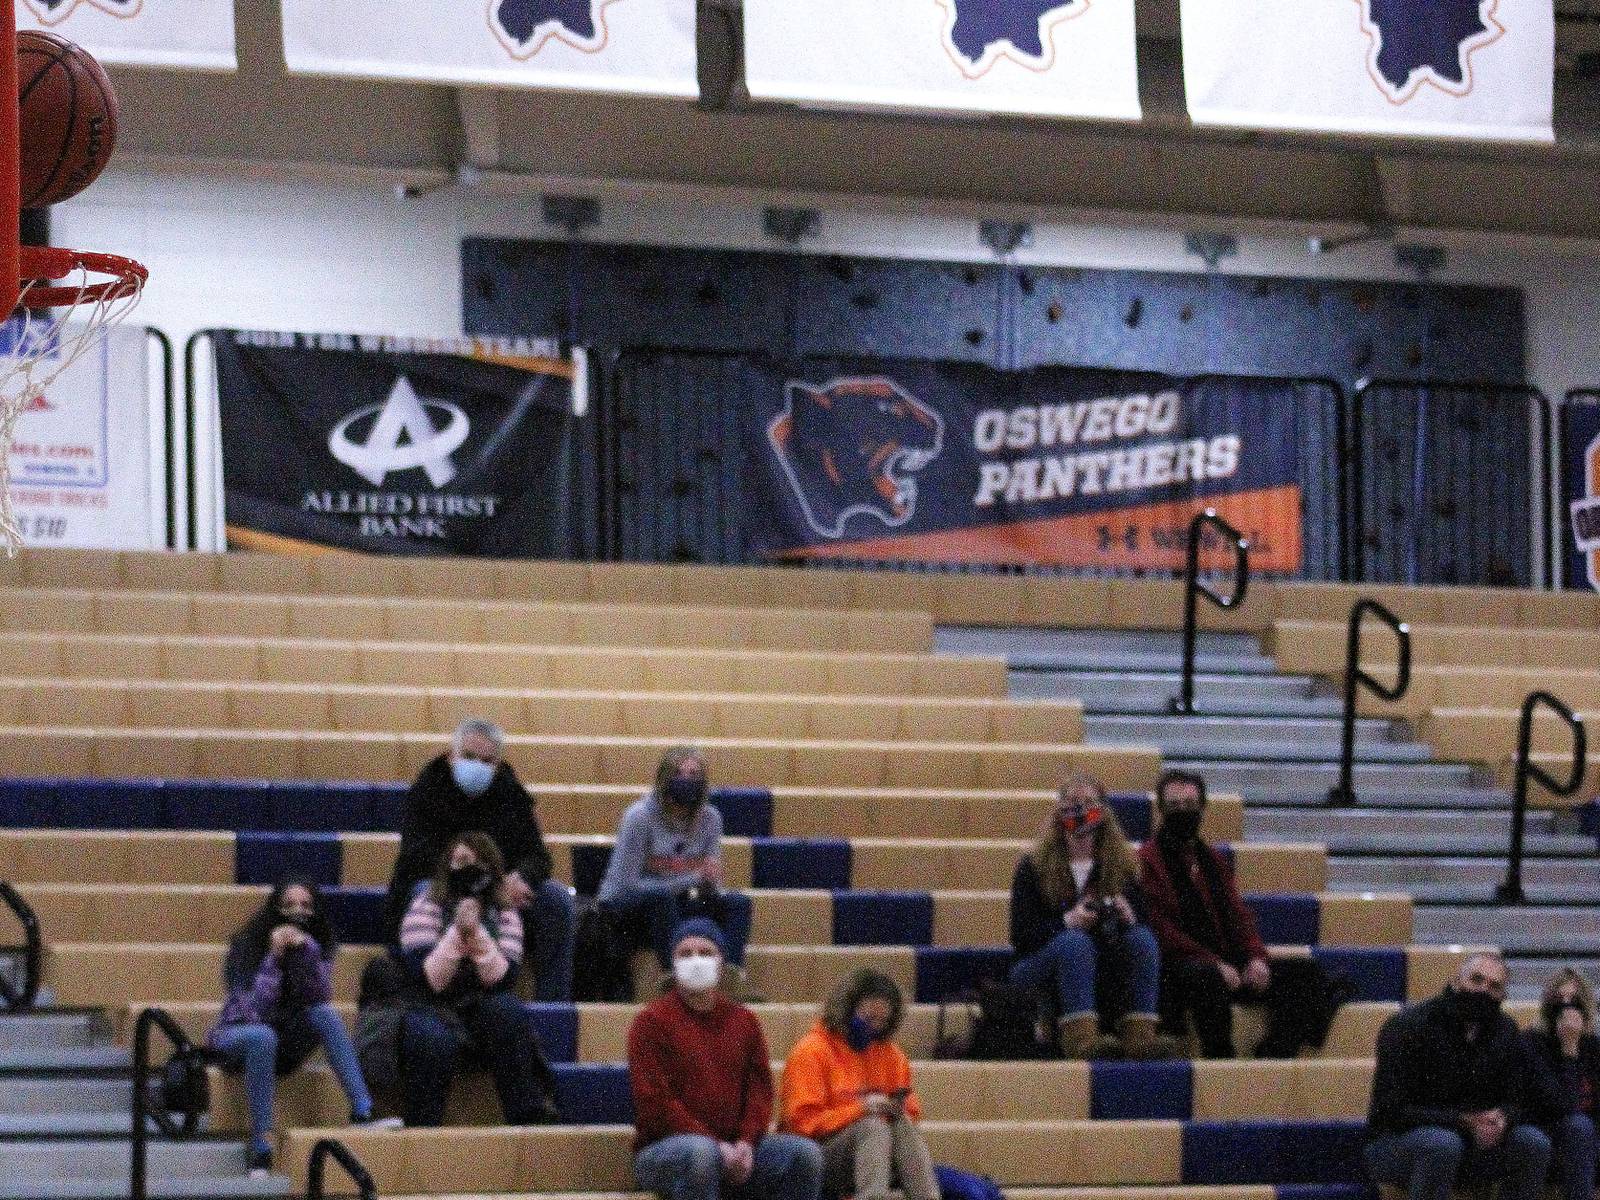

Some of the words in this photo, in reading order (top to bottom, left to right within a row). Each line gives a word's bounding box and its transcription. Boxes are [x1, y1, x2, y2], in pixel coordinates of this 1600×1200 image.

[973, 391, 1182, 451] OSWEGO
[974, 434, 1242, 508] PANTHERS
[301, 490, 412, 514] ALLIED
[417, 492, 501, 517] FIRST
[358, 515, 447, 538] BANK
